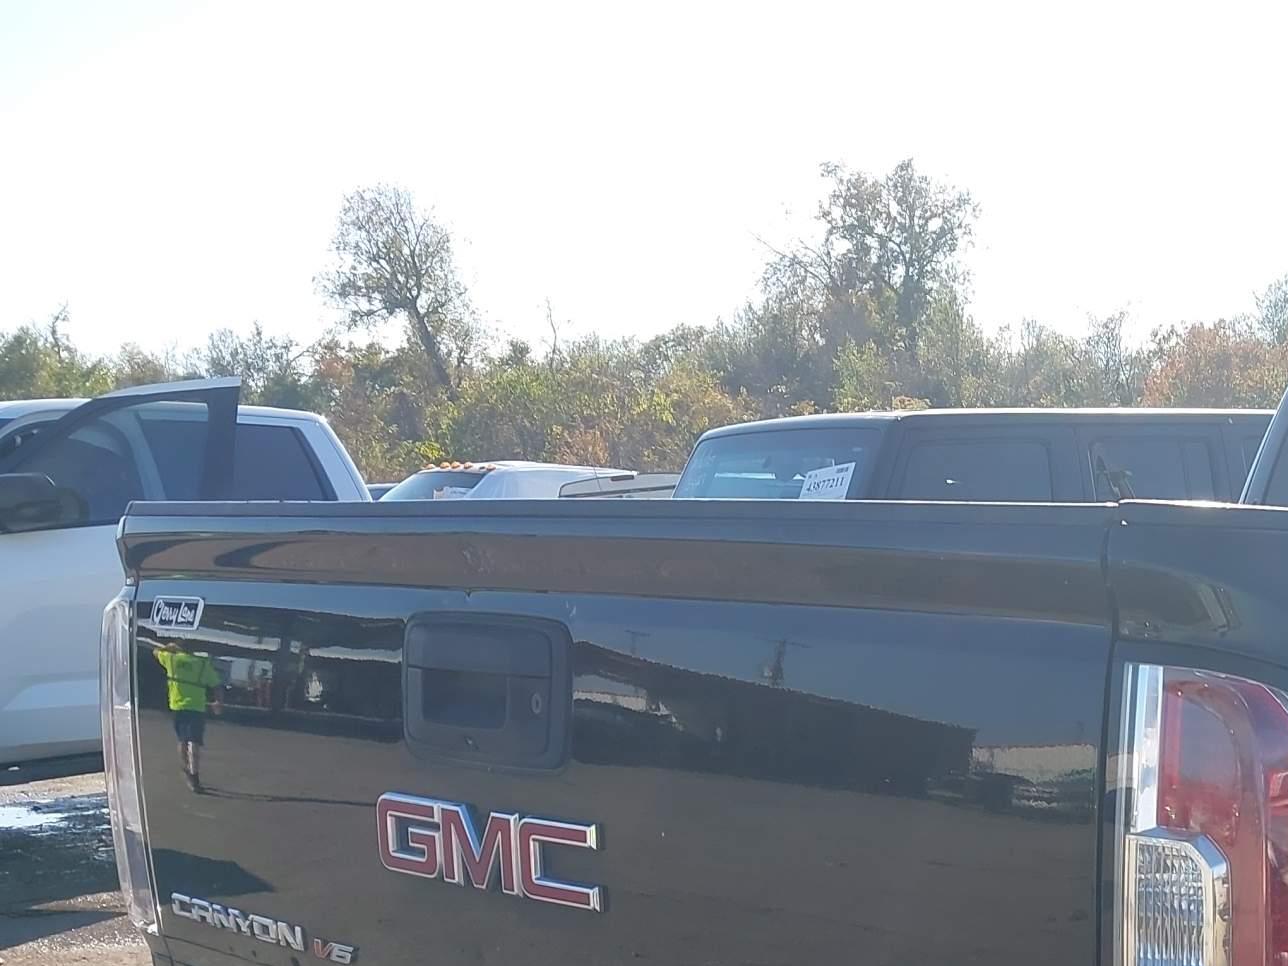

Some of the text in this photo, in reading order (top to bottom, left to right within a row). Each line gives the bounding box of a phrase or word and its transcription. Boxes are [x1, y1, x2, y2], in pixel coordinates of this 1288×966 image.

[377, 792, 600, 912] GMC
[171, 892, 354, 965] CANYON V6
